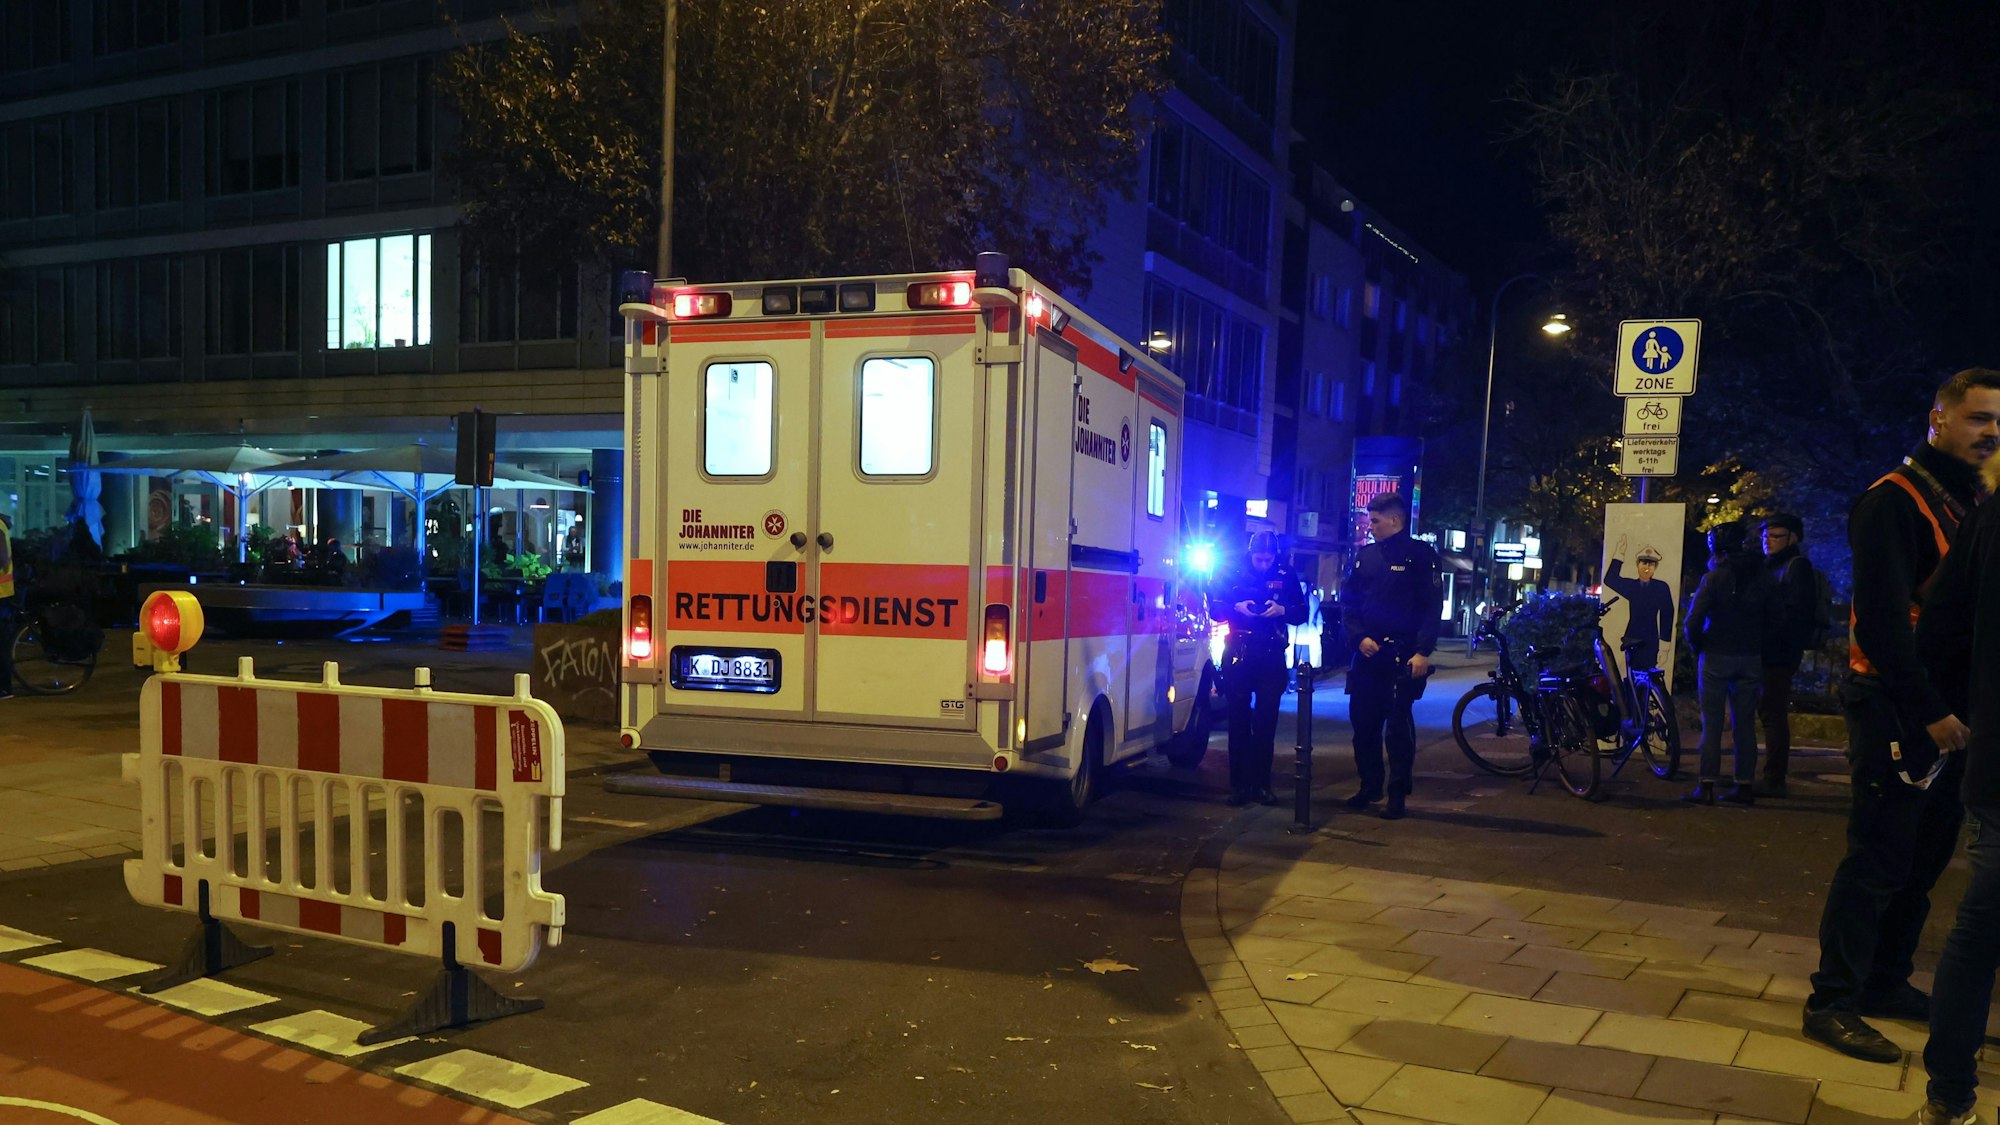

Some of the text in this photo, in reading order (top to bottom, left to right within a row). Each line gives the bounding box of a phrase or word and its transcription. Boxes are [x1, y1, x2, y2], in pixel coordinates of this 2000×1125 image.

[1635, 378, 1674, 389] ZONE
[1078, 395, 1090, 425] DIE
[1643, 422, 1660, 430] frei
[1076, 426, 1116, 465] JOHANNITER
[683, 509, 702, 523] DIE
[679, 525, 755, 539] JOHANNITER
[679, 541, 755, 552] www.johanniter.de
[675, 593, 959, 627] RETTUNGSDIENST
[690, 658, 700, 675] K
[711, 659, 730, 676] DJ
[734, 660, 771, 678] 8831
